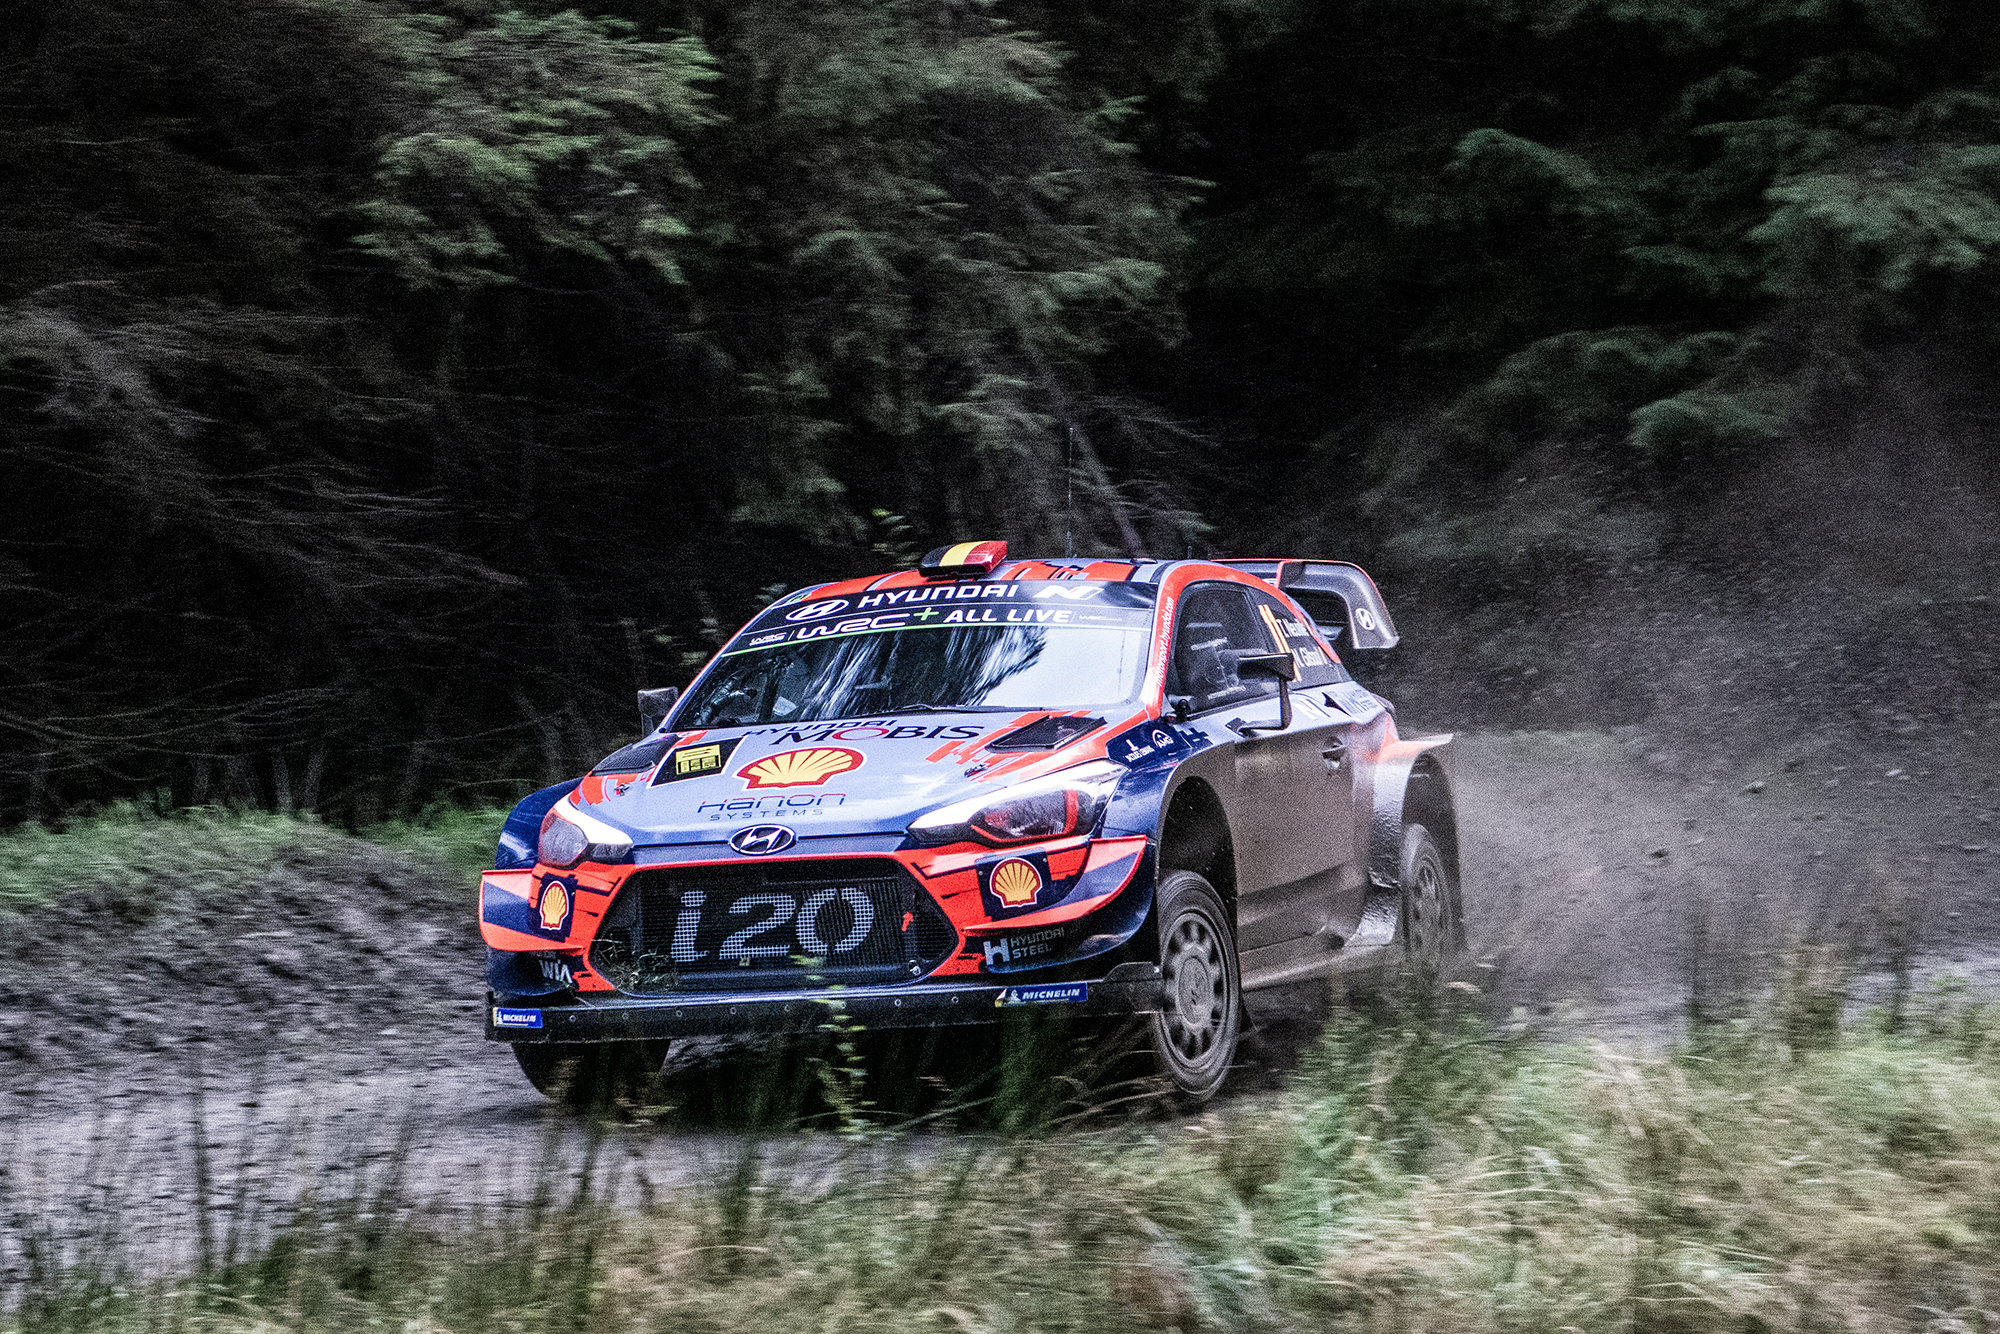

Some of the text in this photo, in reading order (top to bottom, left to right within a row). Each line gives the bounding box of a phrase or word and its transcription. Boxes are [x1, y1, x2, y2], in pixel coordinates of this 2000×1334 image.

[858, 584, 1020, 608] HYUNDAI
[943, 609, 998, 623] ALL
[1006, 609, 1073, 624] LIVE
[742, 719, 898, 737] HYUNDAI
[769, 725, 986, 746] MOBIS
[709, 809, 824, 822] SYSTEMS
[670, 888, 875, 963] i20
[1010, 927, 1065, 947] HYUNDAI
[1012, 944, 1053, 960] STEEL
[1022, 988, 1081, 1000] MICHELIN
